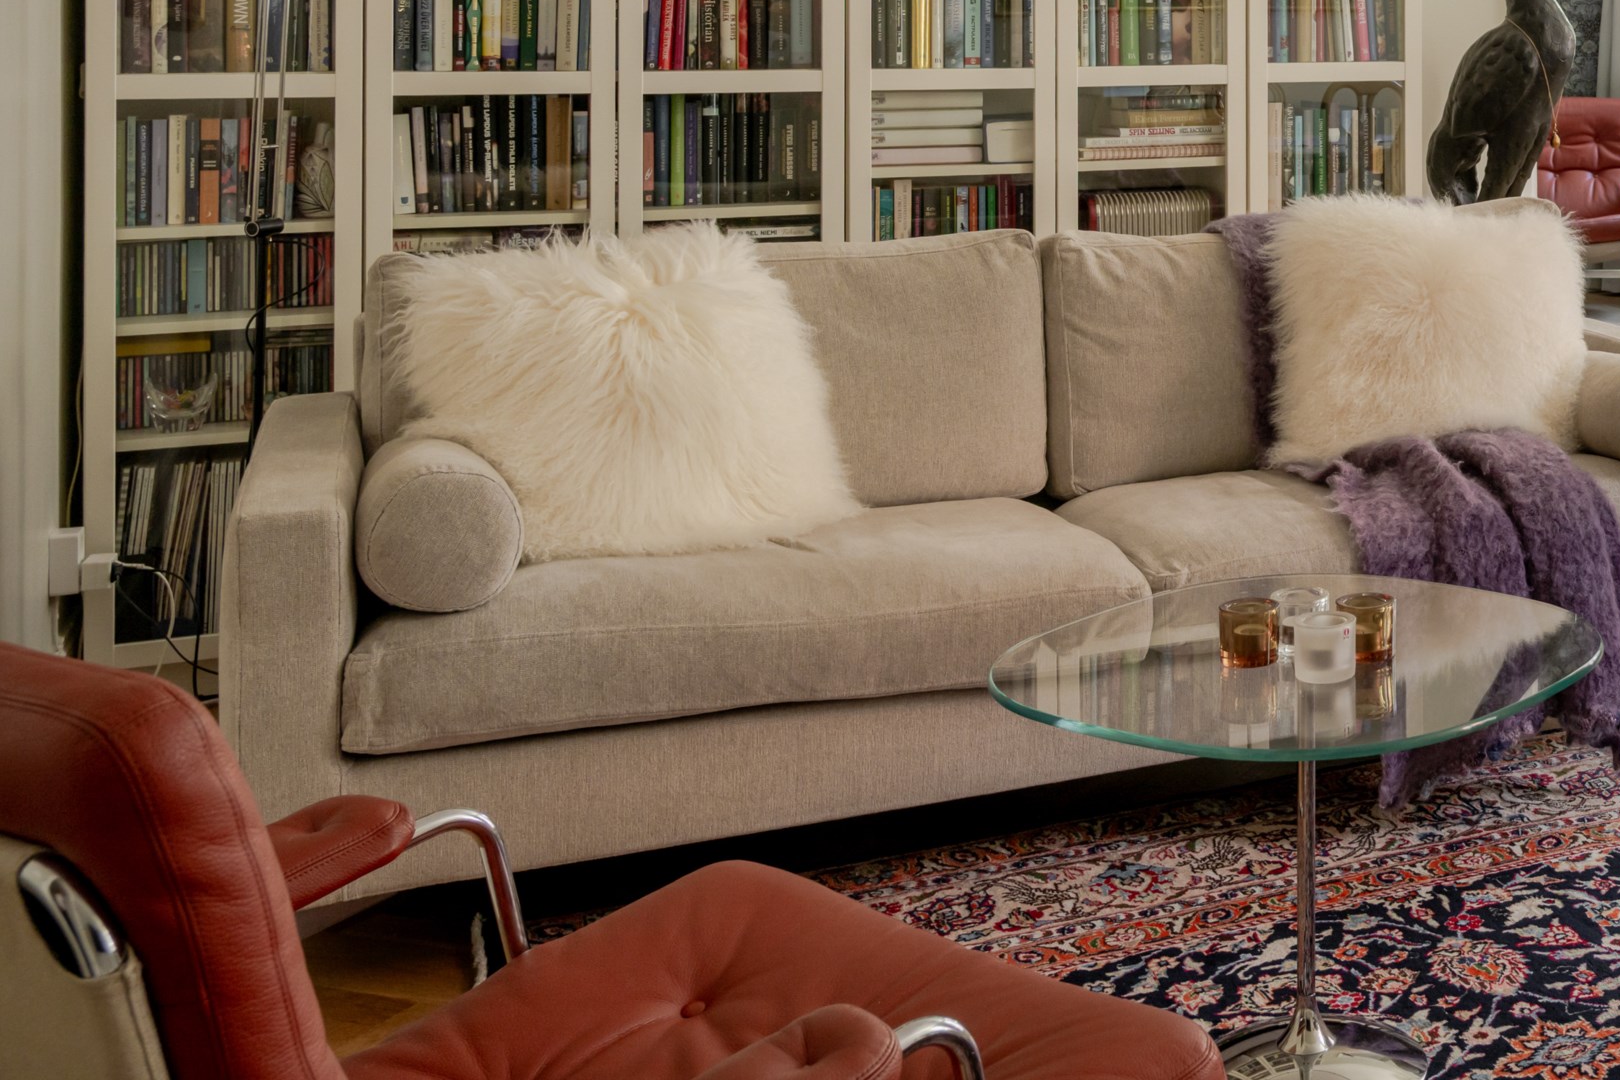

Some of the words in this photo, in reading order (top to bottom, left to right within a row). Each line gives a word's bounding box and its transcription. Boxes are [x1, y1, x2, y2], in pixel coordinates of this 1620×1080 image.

[420, 11, 431, 31] ÖVER
[420, 31, 430, 53] HAVET
[1128, 128, 1146, 136] SPIN
[1147, 127, 1176, 136] SELLING
[785, 146, 794, 180] LARSSON
